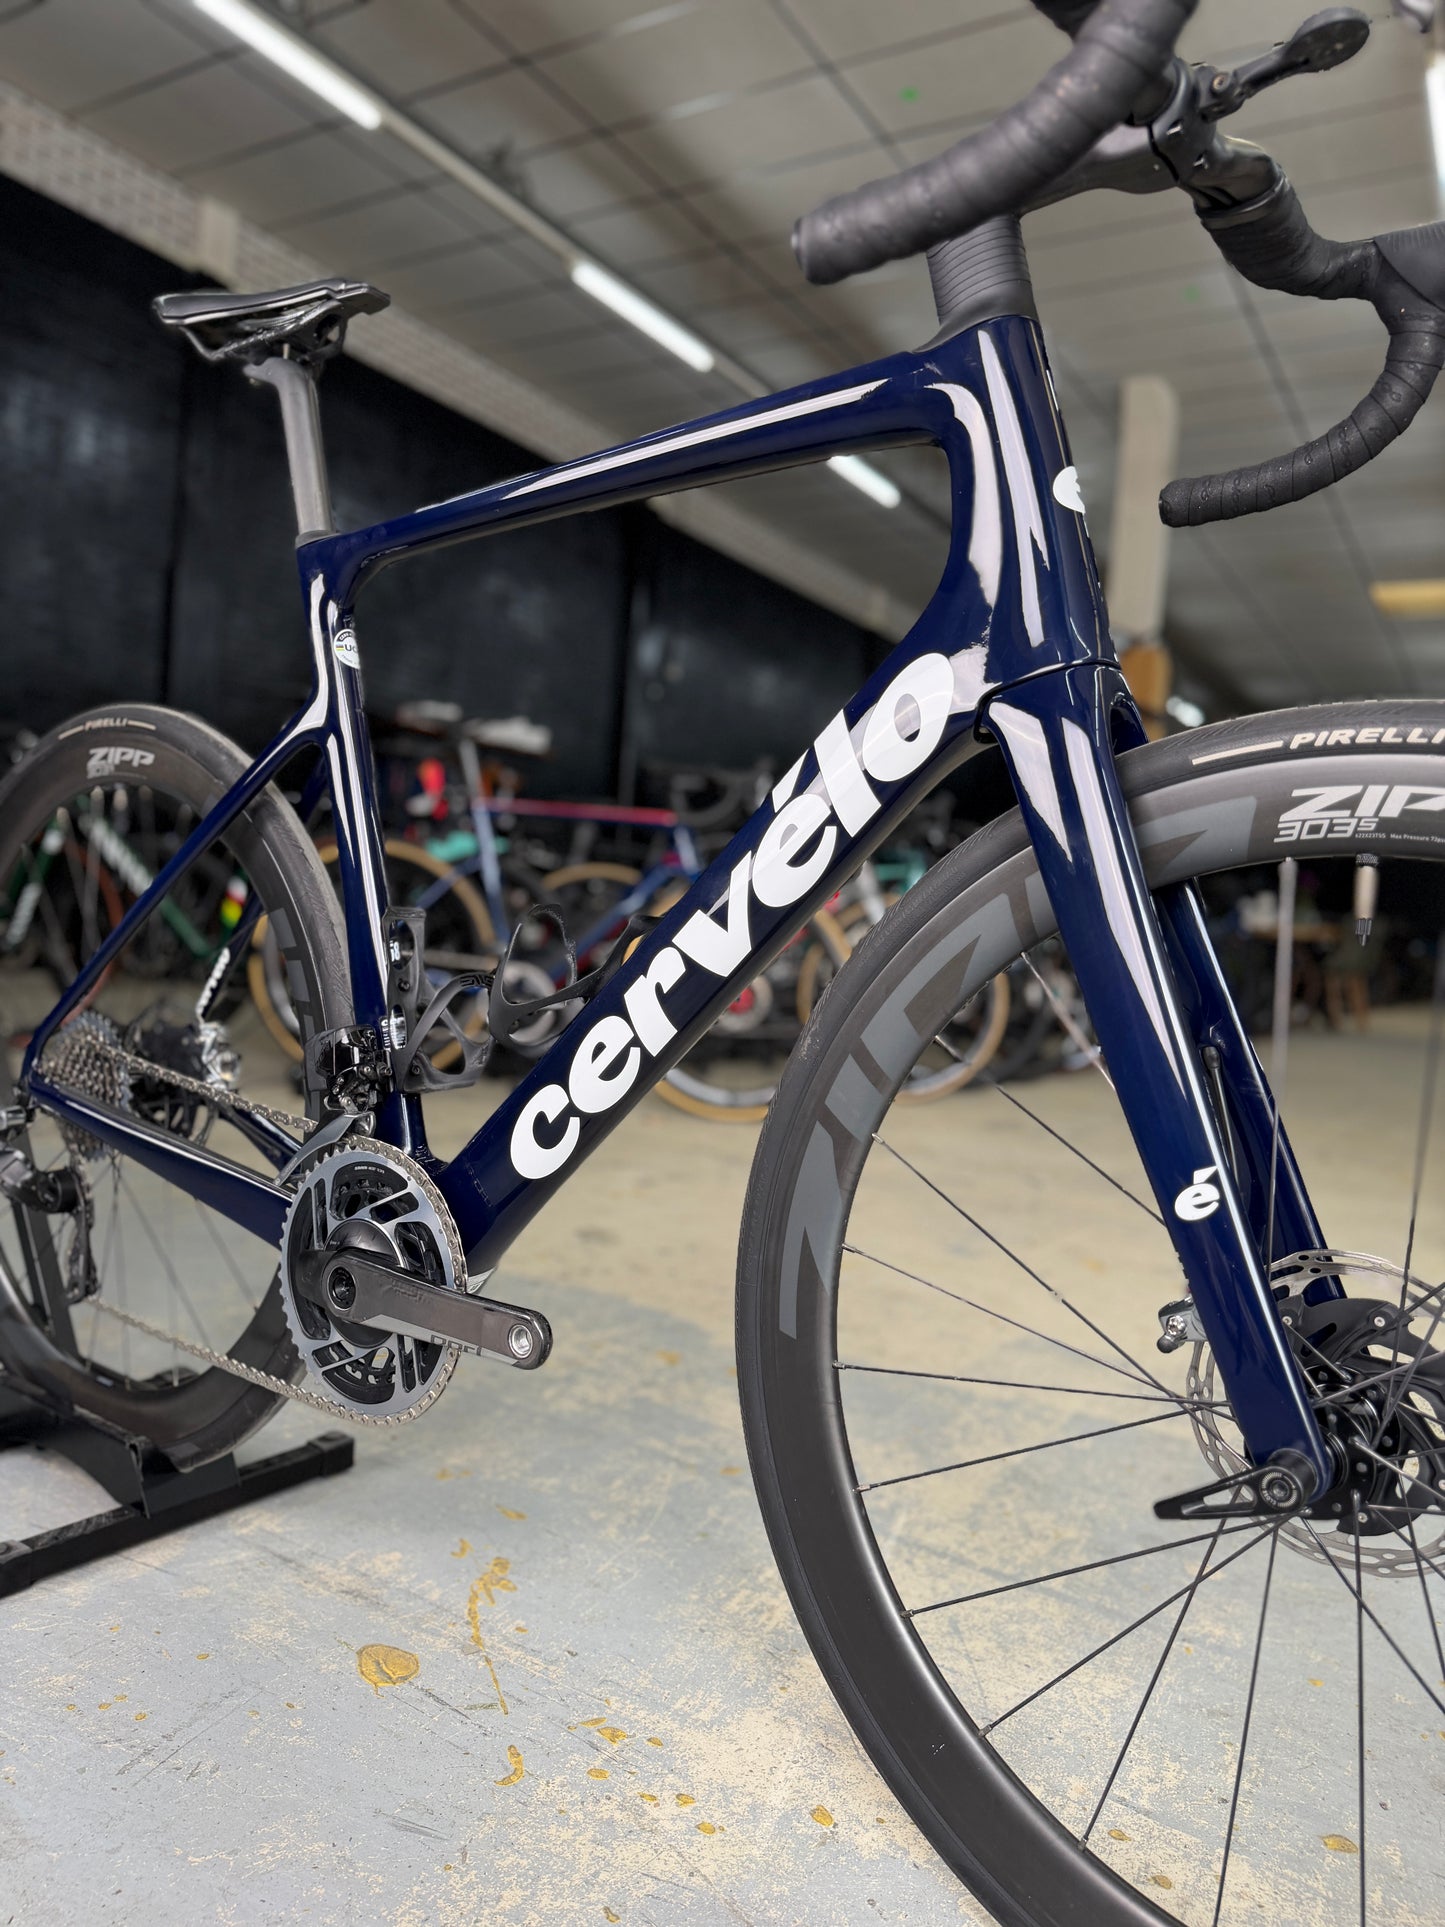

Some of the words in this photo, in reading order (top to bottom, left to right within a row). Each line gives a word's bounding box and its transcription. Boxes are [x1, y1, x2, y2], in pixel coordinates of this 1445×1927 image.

[1290, 727, 1445, 750] PIRELLI
[87, 746, 155, 767] ZIPP
[510, 652, 954, 1179] cervélo
